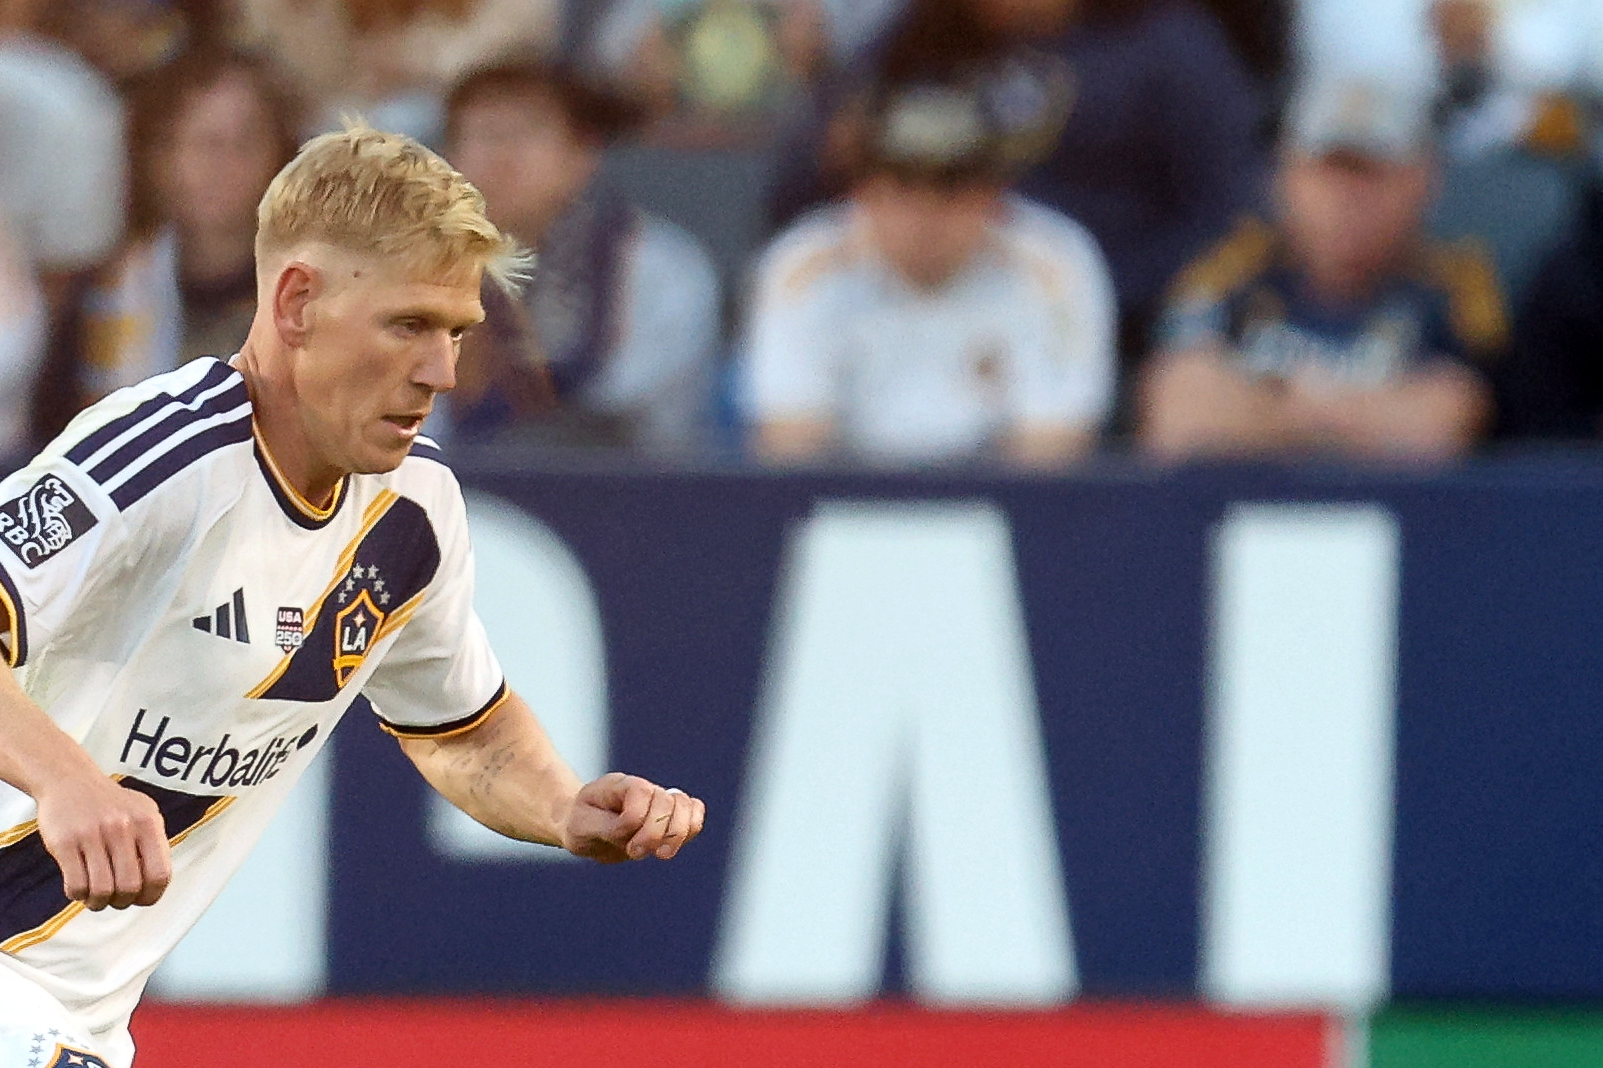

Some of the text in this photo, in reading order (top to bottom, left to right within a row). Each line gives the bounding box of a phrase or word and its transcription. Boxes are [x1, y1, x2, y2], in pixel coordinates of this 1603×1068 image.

[278, 609, 303, 623] USA
[275, 630, 303, 647] 250
[341, 626, 367, 652] LA
